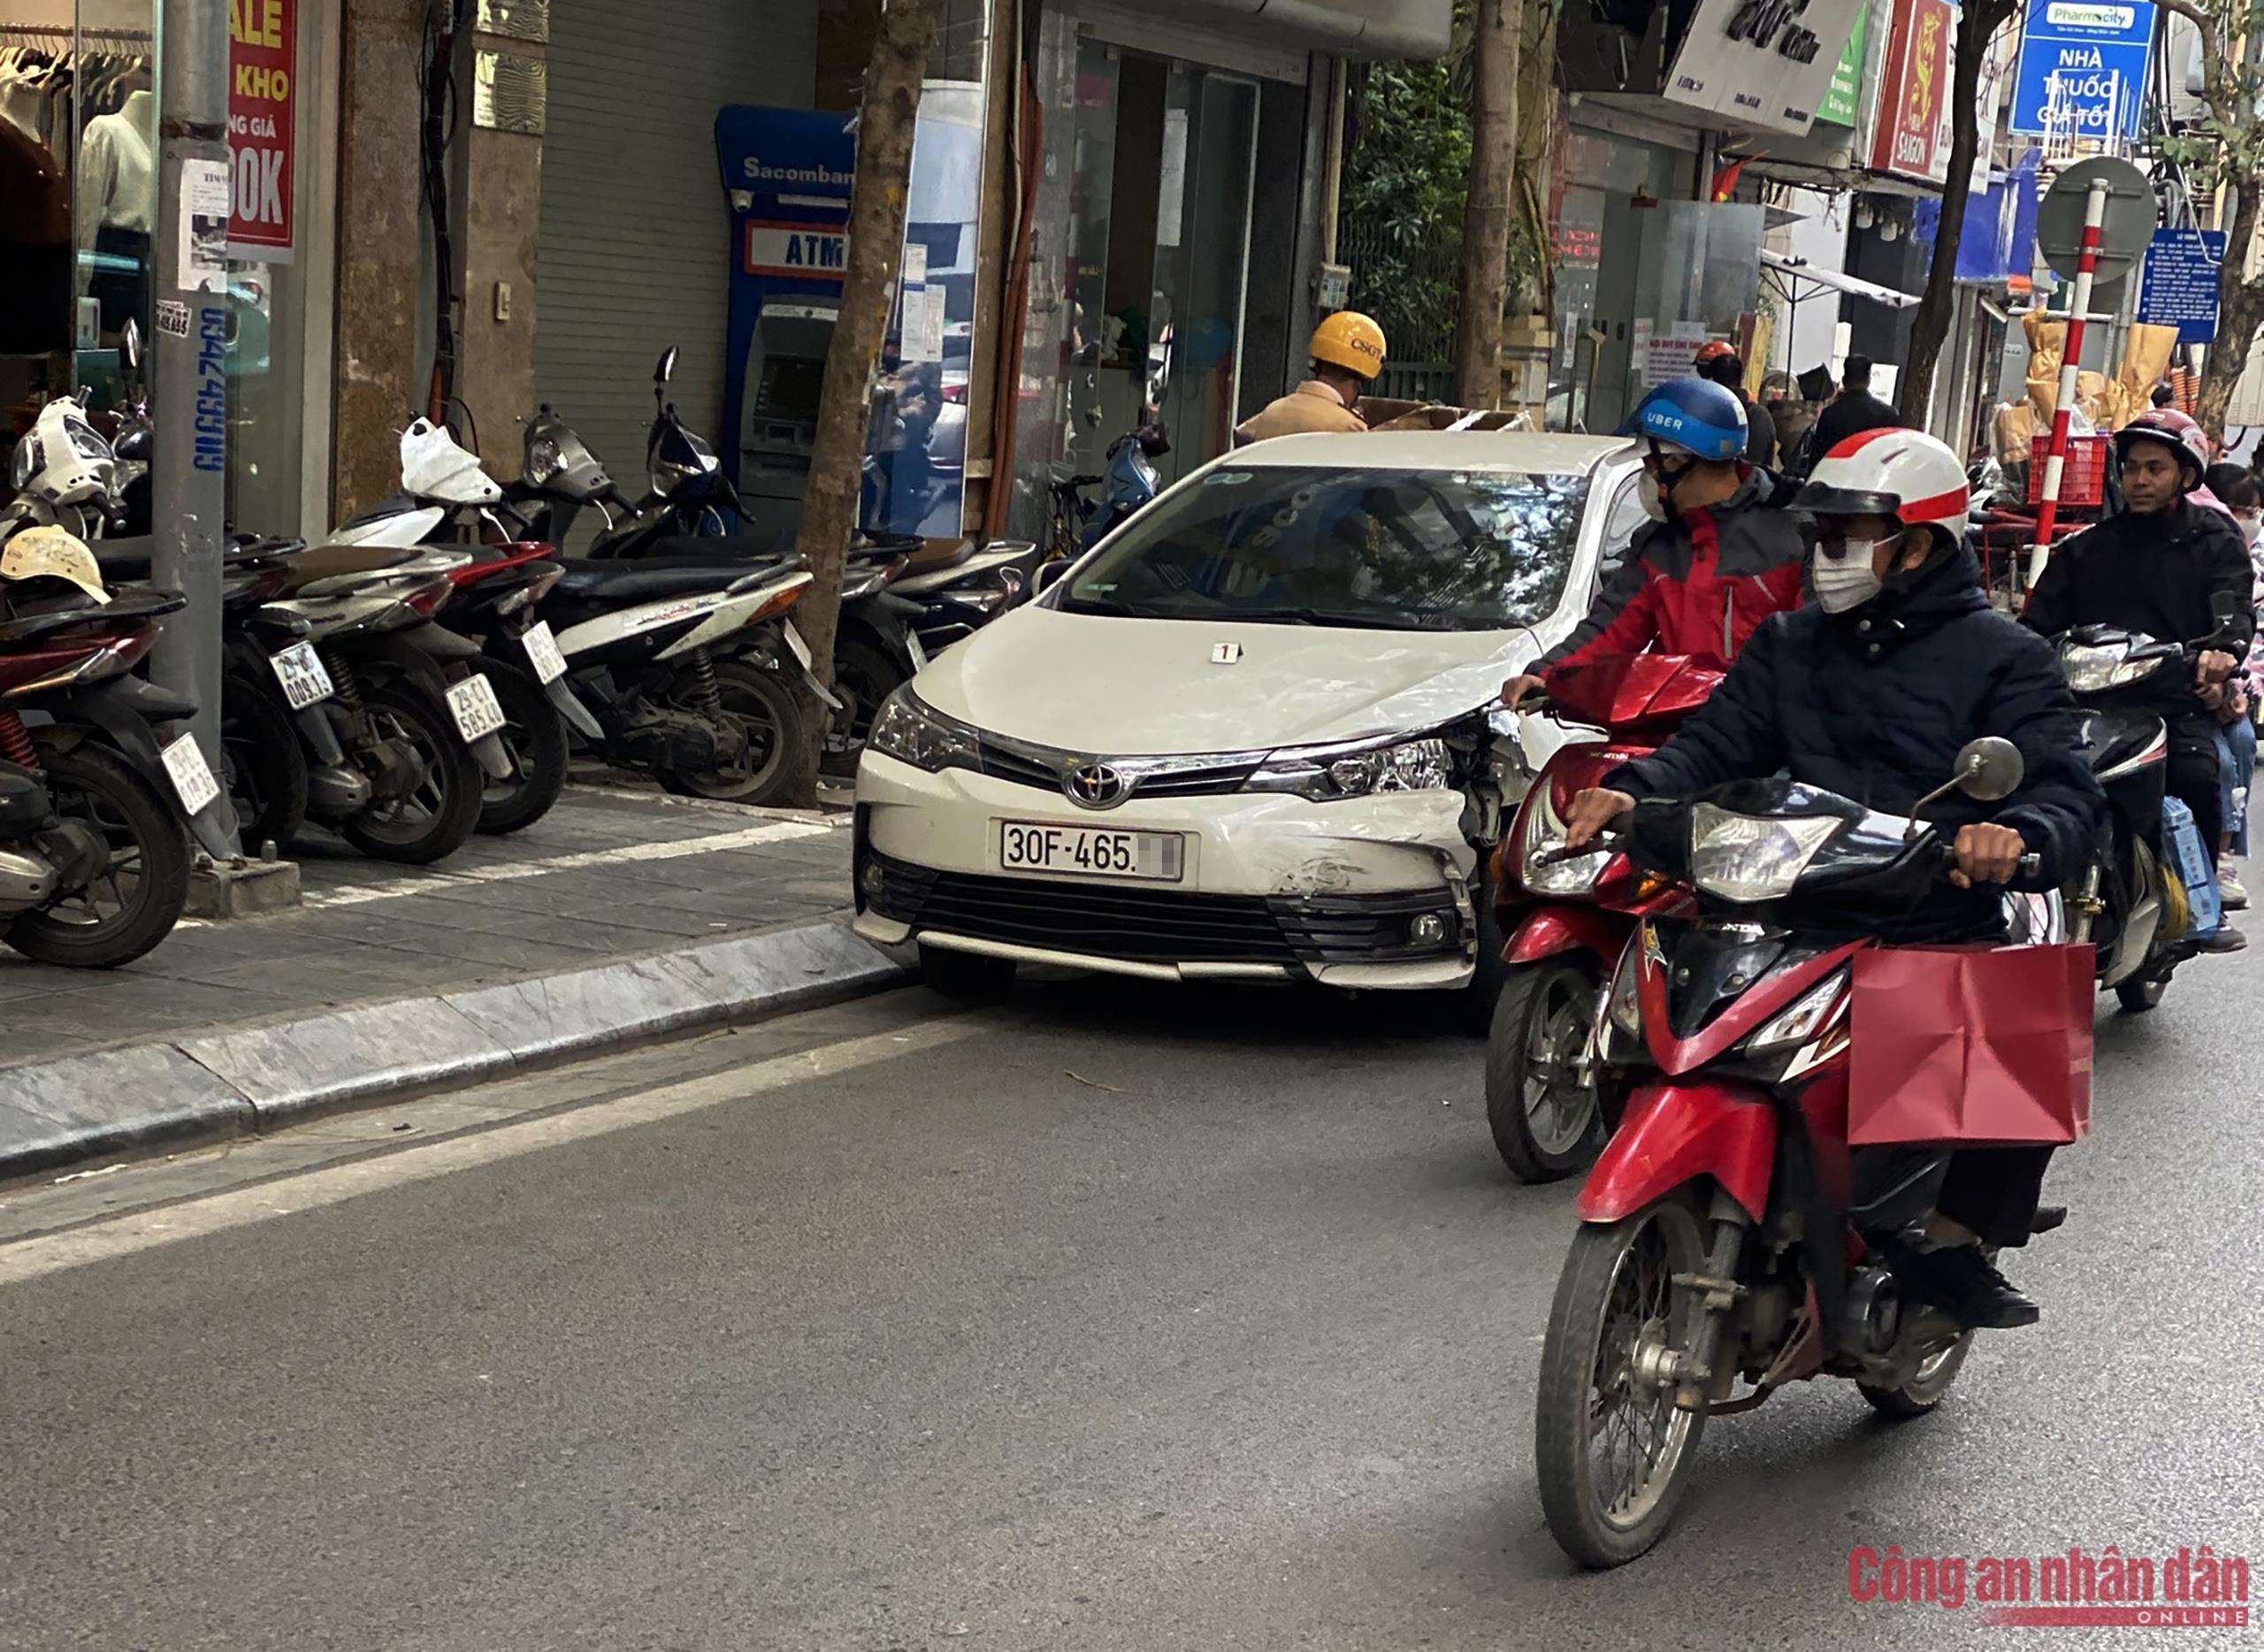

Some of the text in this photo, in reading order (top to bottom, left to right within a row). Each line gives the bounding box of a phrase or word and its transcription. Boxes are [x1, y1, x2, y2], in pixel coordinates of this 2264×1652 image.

[2058, 46, 2103, 69] NHÀ
[235, 63, 289, 103] KHO
[250, 114, 276, 139] GIÁ
[743, 157, 855, 185] Sacomban
[785, 233, 844, 268] ATM
[1350, 338, 1382, 360] CSGT
[1647, 411, 1683, 431] UBER
[1221, 645, 1229, 660] 1
[1007, 828, 1174, 874] 30F-465.
